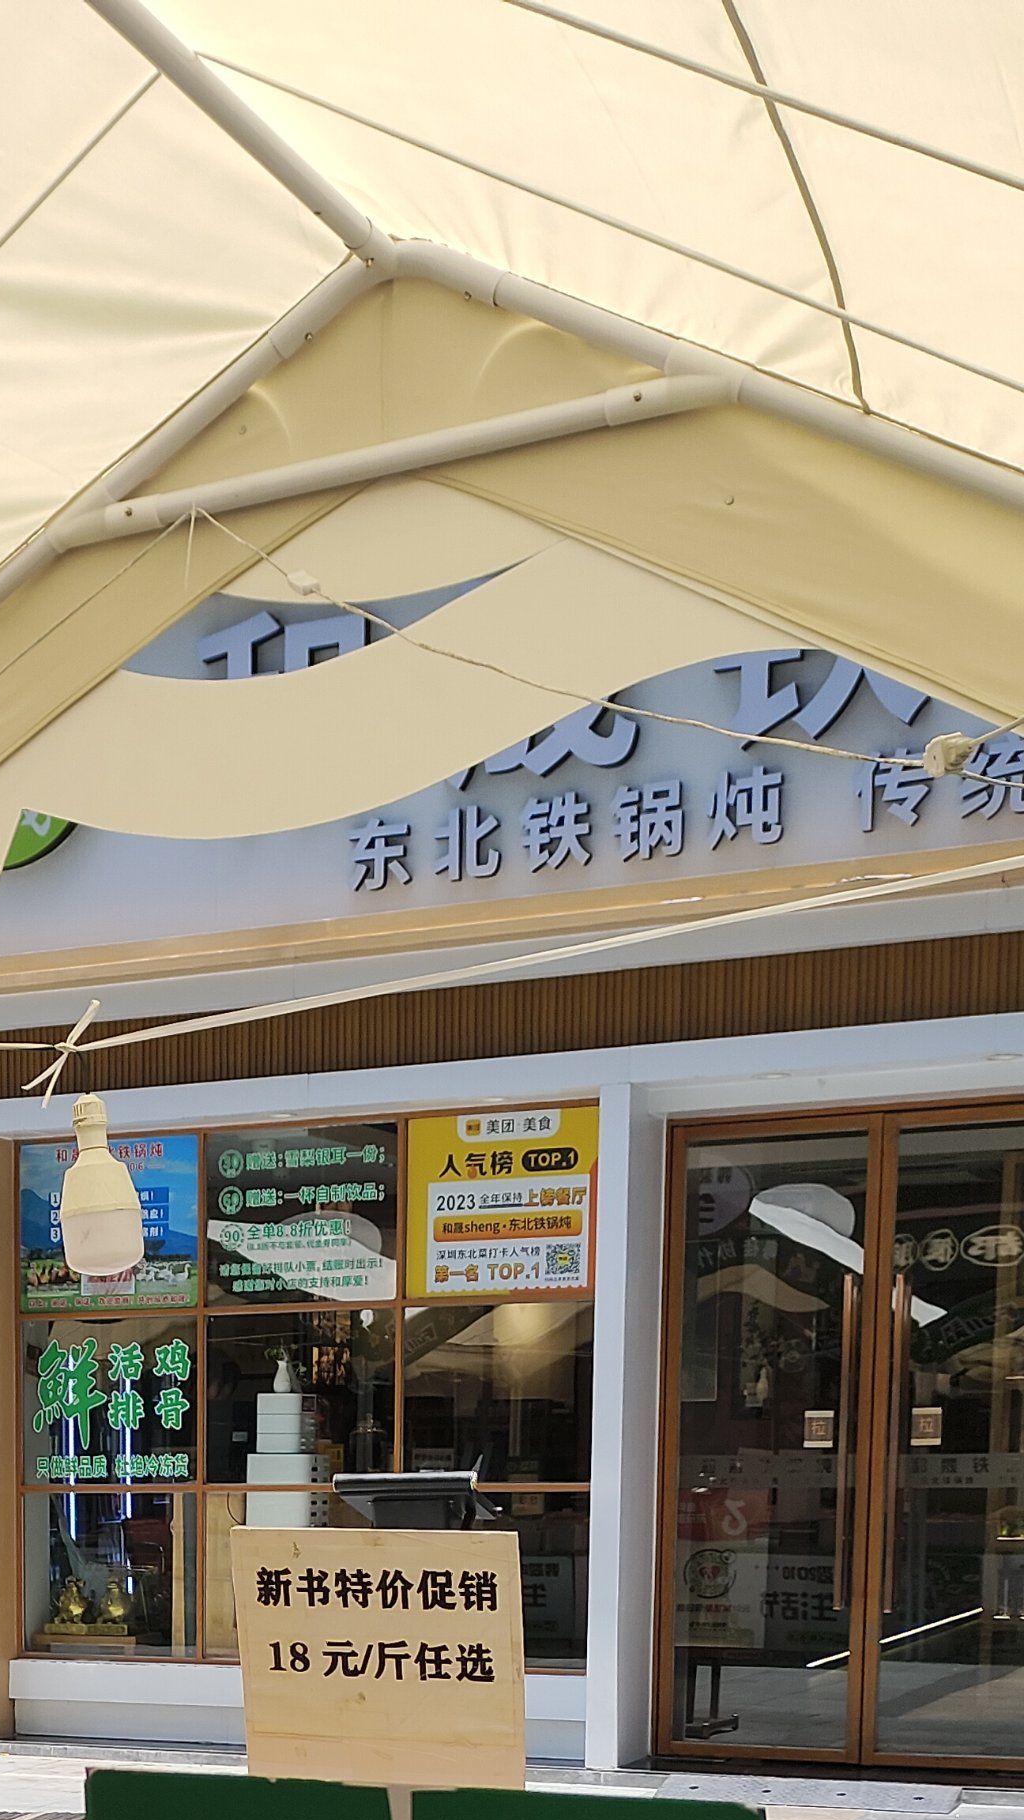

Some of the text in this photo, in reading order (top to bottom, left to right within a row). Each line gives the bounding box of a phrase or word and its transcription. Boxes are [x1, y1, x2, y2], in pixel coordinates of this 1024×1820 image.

[349, 767, 784, 889] 东北铁锅炖
[486, 1116, 552, 1135] 美团 美食
[438, 1150, 514, 1179] 人气榜
[436, 1186, 588, 1212] 2023 全年保持 上榜餐厅
[436, 1246, 541, 1261] 深圳东北菜打卡人气榜
[434, 1263, 479, 1284] 第一名
[32, 1337, 108, 1450] 鲜
[36, 1455, 108, 1479] 只做鲜品质
[256, 1566, 499, 1612] 新书特价促销
[268, 1639, 496, 1684] 18 元/斤任选
